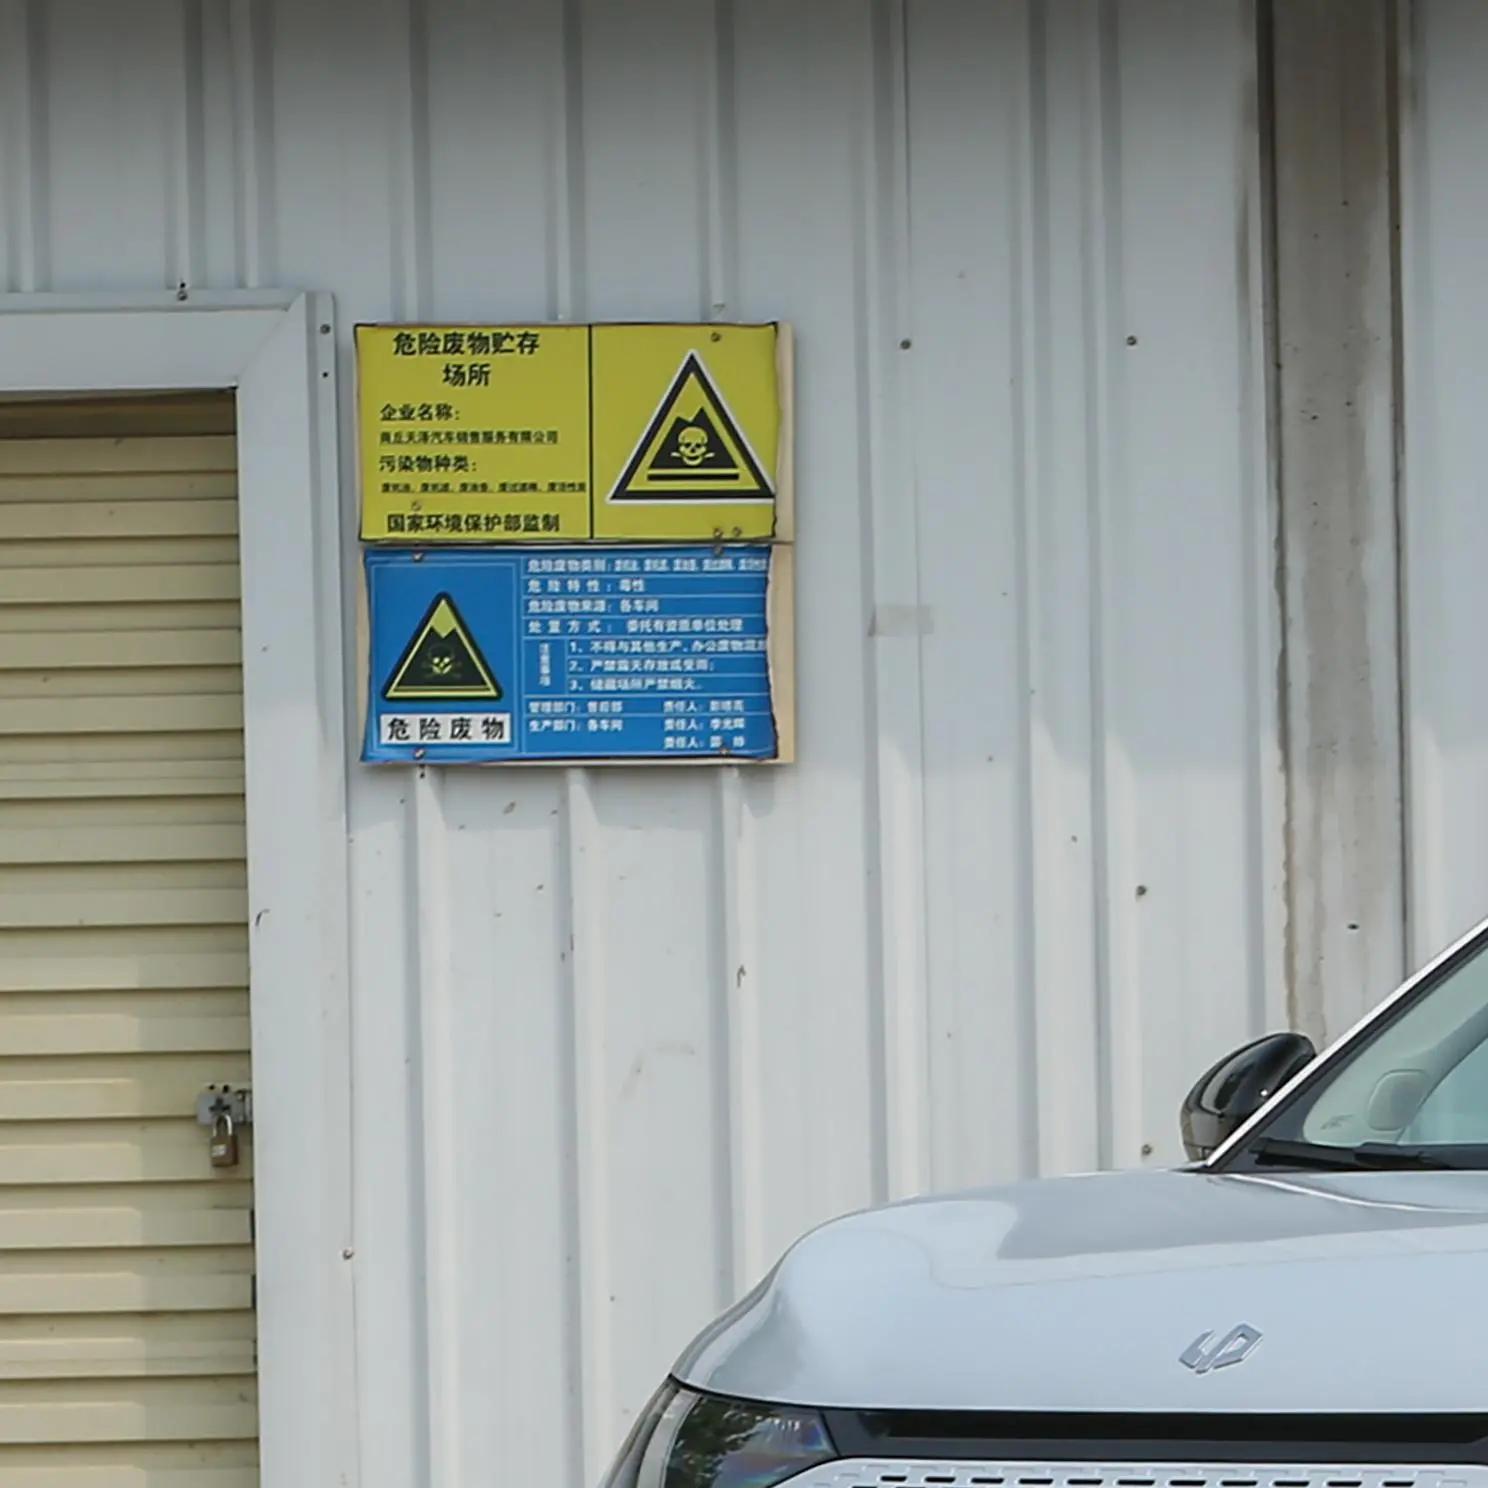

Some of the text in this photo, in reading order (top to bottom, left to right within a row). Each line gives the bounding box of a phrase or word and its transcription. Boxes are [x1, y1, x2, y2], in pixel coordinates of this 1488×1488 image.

[393, 331, 540, 356] 危险废物贮存
[442, 363, 491, 387] 场所
[380, 403, 461, 422] 企业名称：
[379, 455, 478, 472] 污染物种类：
[387, 513, 561, 534] 国家环境保护部监制
[387, 716, 506, 741] 危险废物
